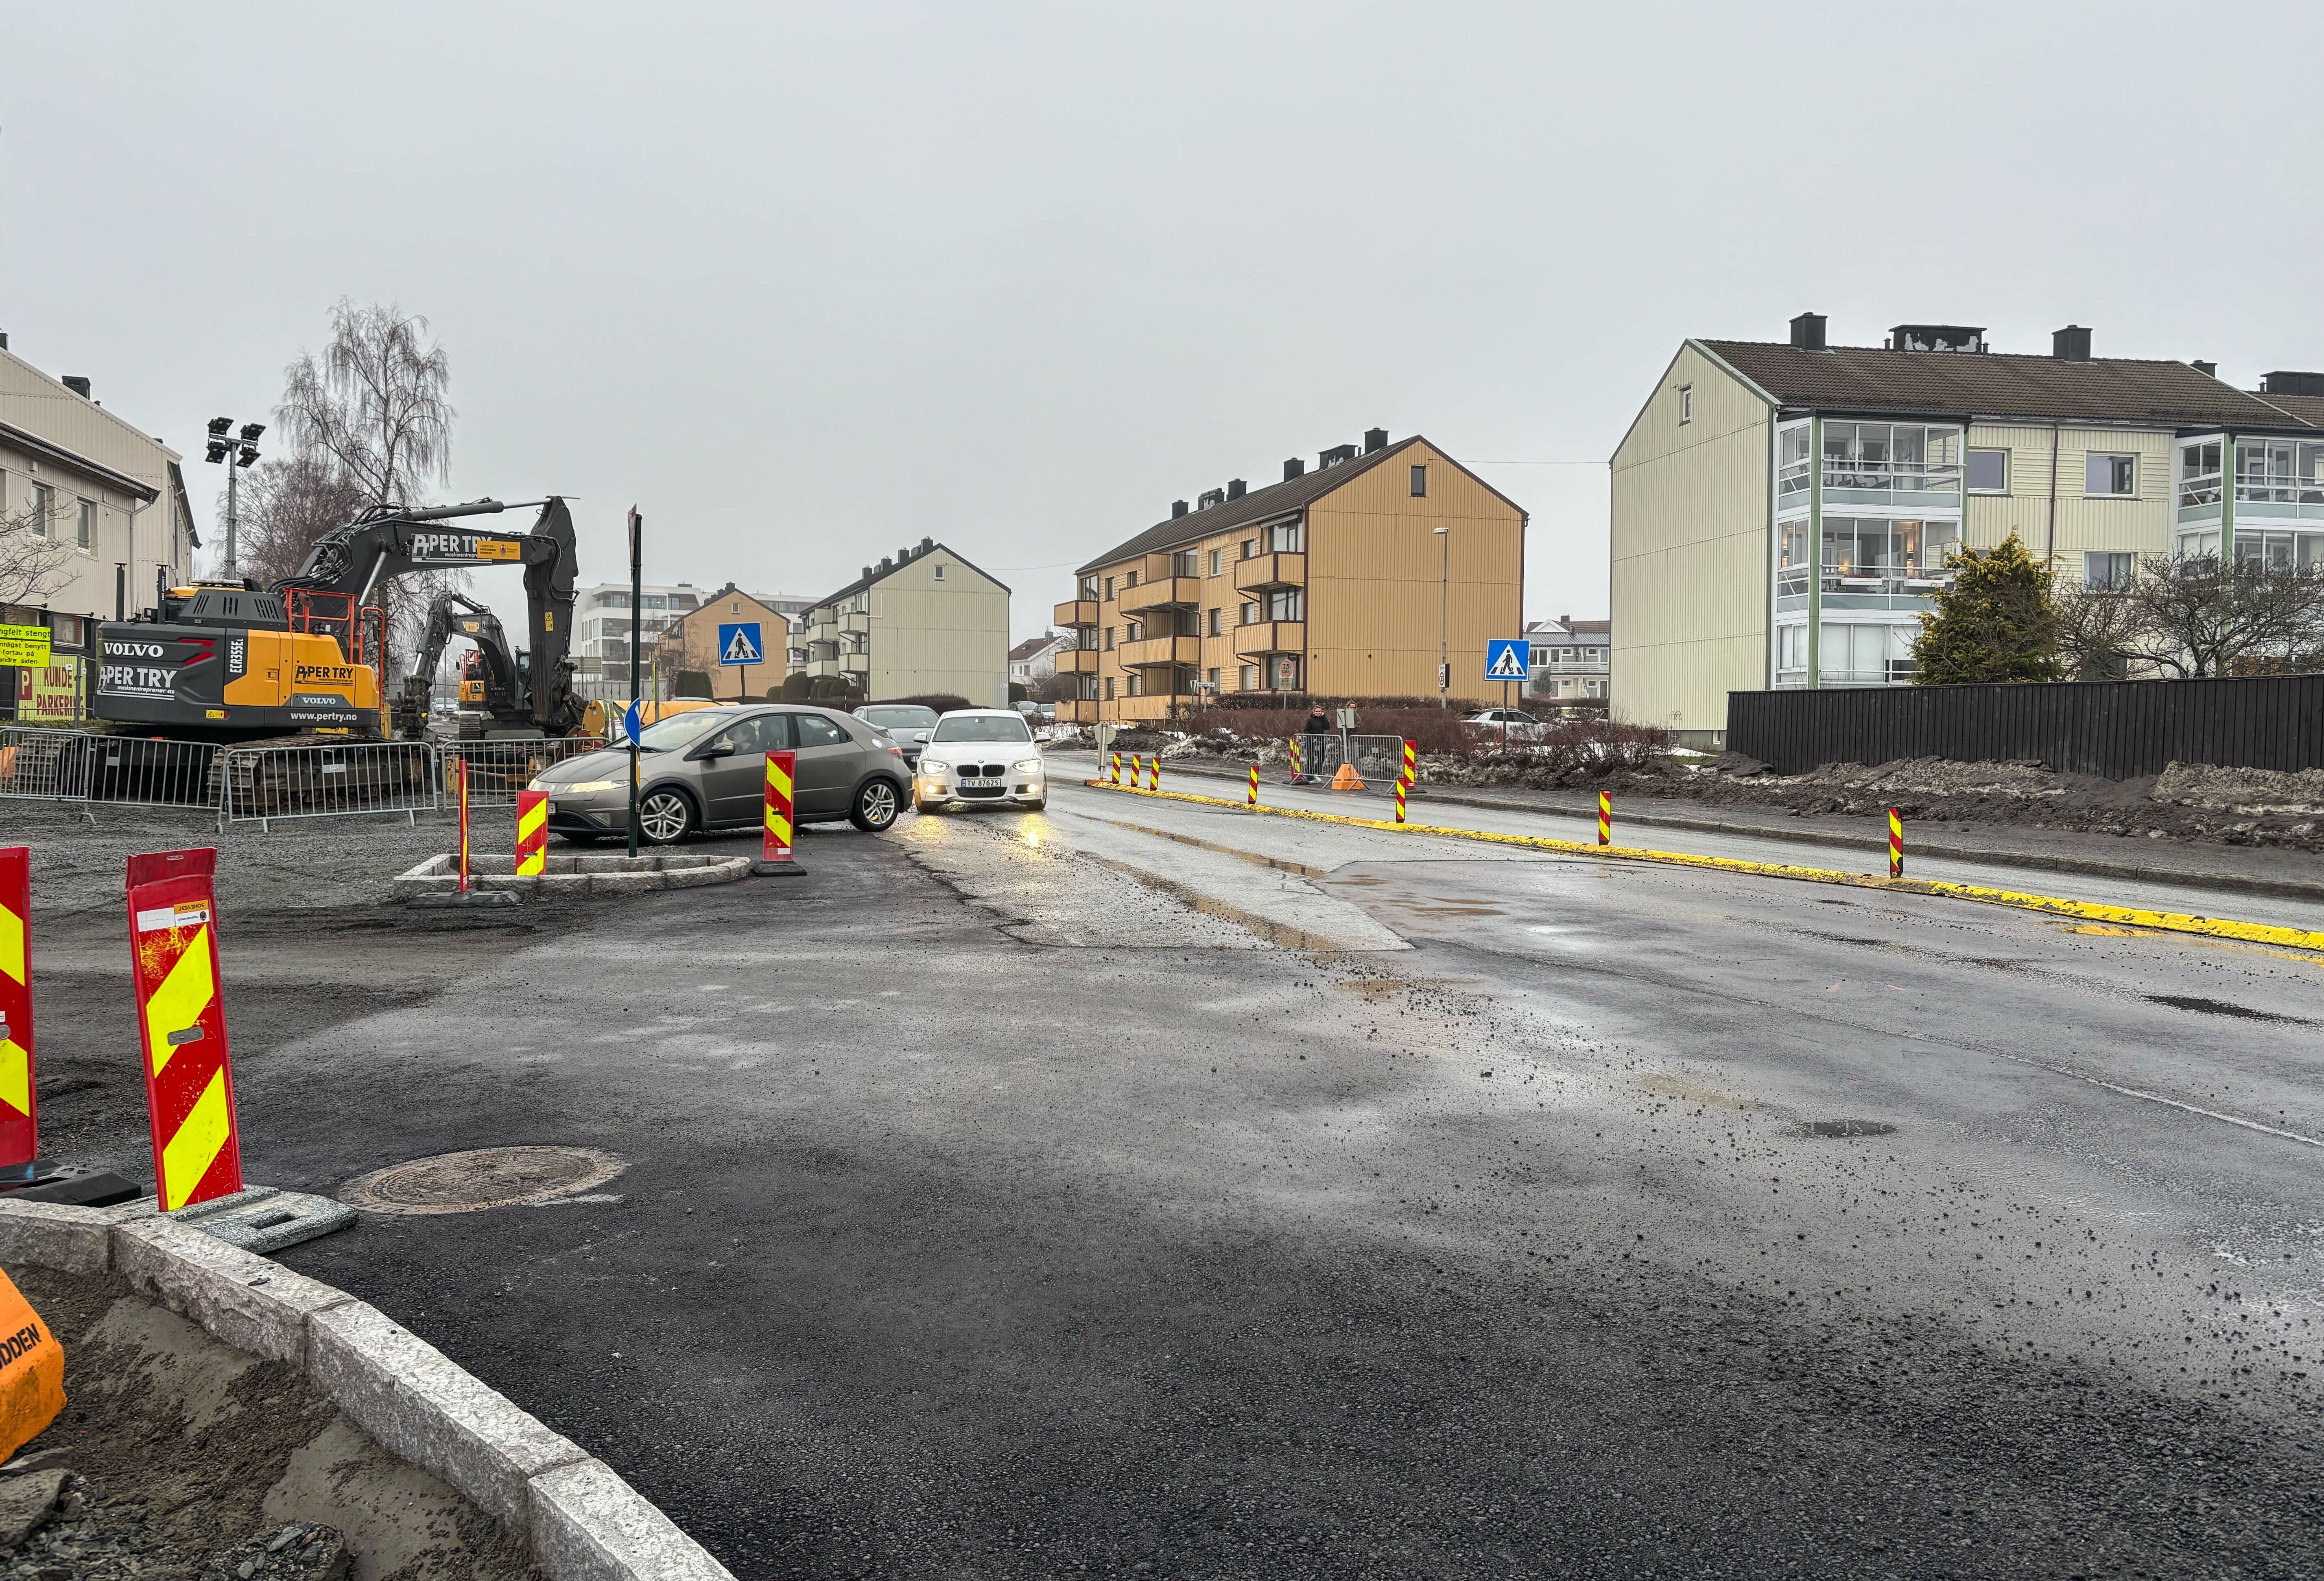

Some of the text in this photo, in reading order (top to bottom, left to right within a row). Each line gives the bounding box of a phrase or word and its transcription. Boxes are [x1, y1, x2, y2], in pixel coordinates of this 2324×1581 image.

[26, 630, 50, 639] stengt
[104, 642, 164, 657] VOLVO
[137, 668, 177, 688] TRY
[332, 667, 354, 679] TRY
[22, 671, 30, 695] P
[290, 712, 357, 722] www.pertry.no
